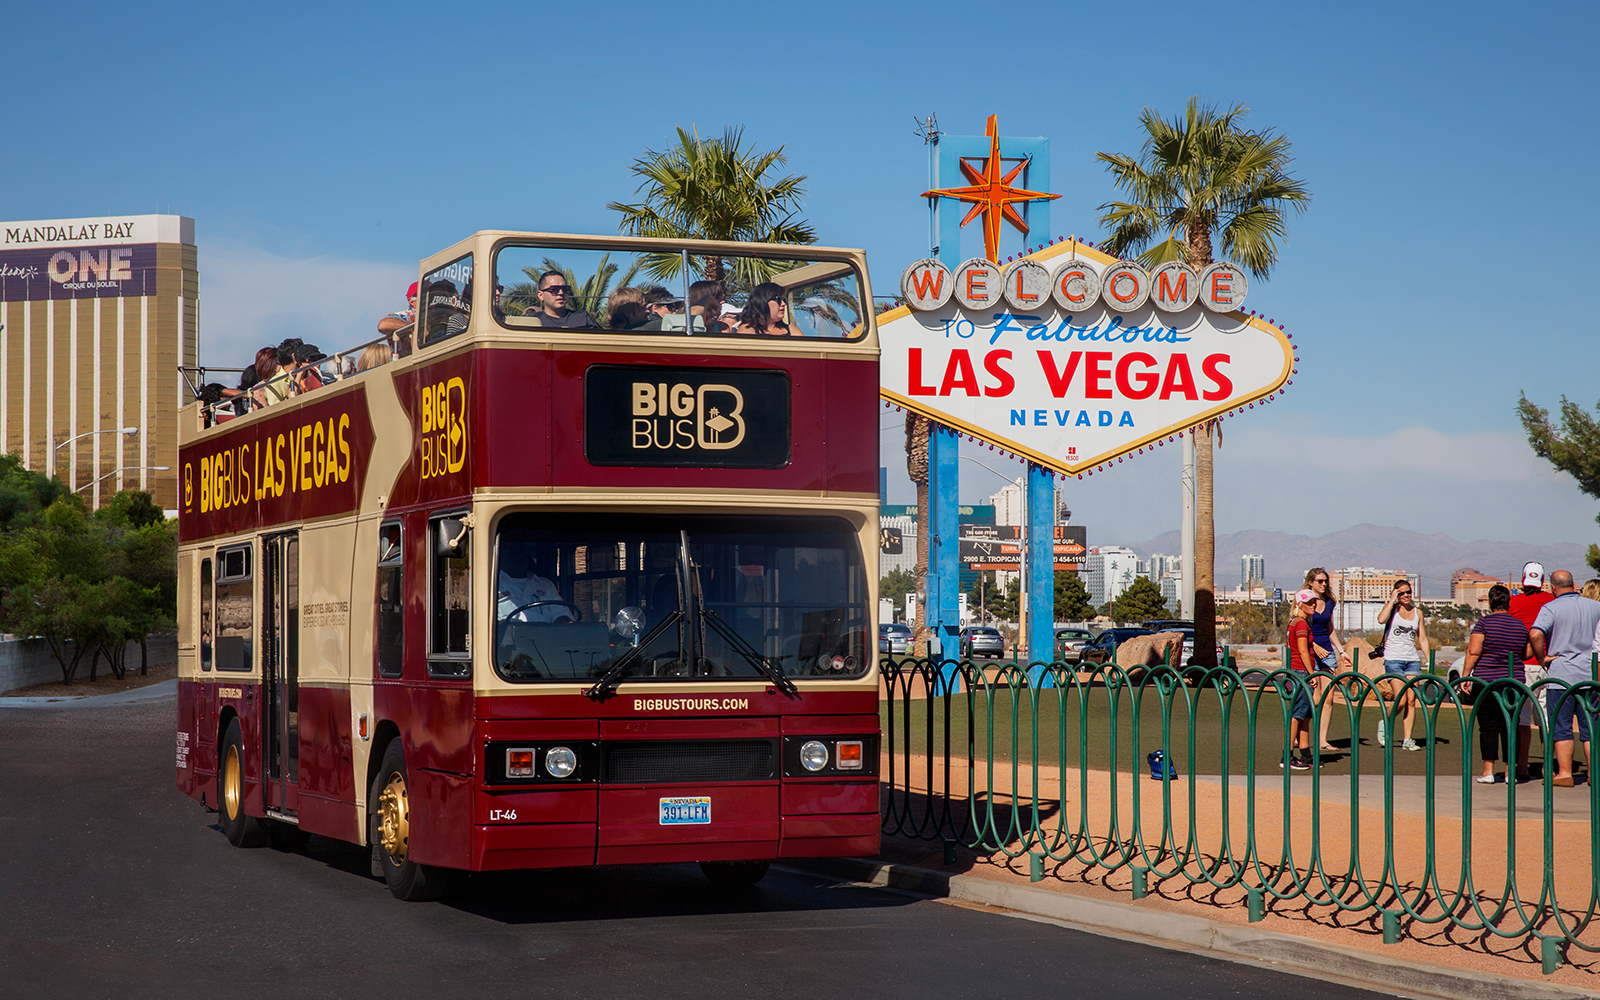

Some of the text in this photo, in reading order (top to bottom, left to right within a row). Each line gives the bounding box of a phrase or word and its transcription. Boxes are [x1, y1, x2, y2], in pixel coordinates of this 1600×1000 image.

[5, 222, 134, 243] MANDALAY BAY
[48, 248, 133, 284] ONE
[62, 281, 86, 290] CIRQUE
[86, 281, 96, 289] DU
[911, 268, 1235, 304] WELCOME
[939, 312, 1192, 345] TO Fabulous
[907, 347, 1234, 401] LAS VEGAS
[422, 381, 446, 433] BIG
[632, 382, 695, 417] BIG
[632, 419, 695, 449] BUS
[1010, 409, 1135, 428] NEVADA
[255, 433, 286, 501] LAS
[290, 413, 350, 493] VEGAS
[422, 433, 447, 480] BUS
[633, 698, 749, 711] BIGBUSTOURS.COM
[490, 809, 517, 821] LT-46
